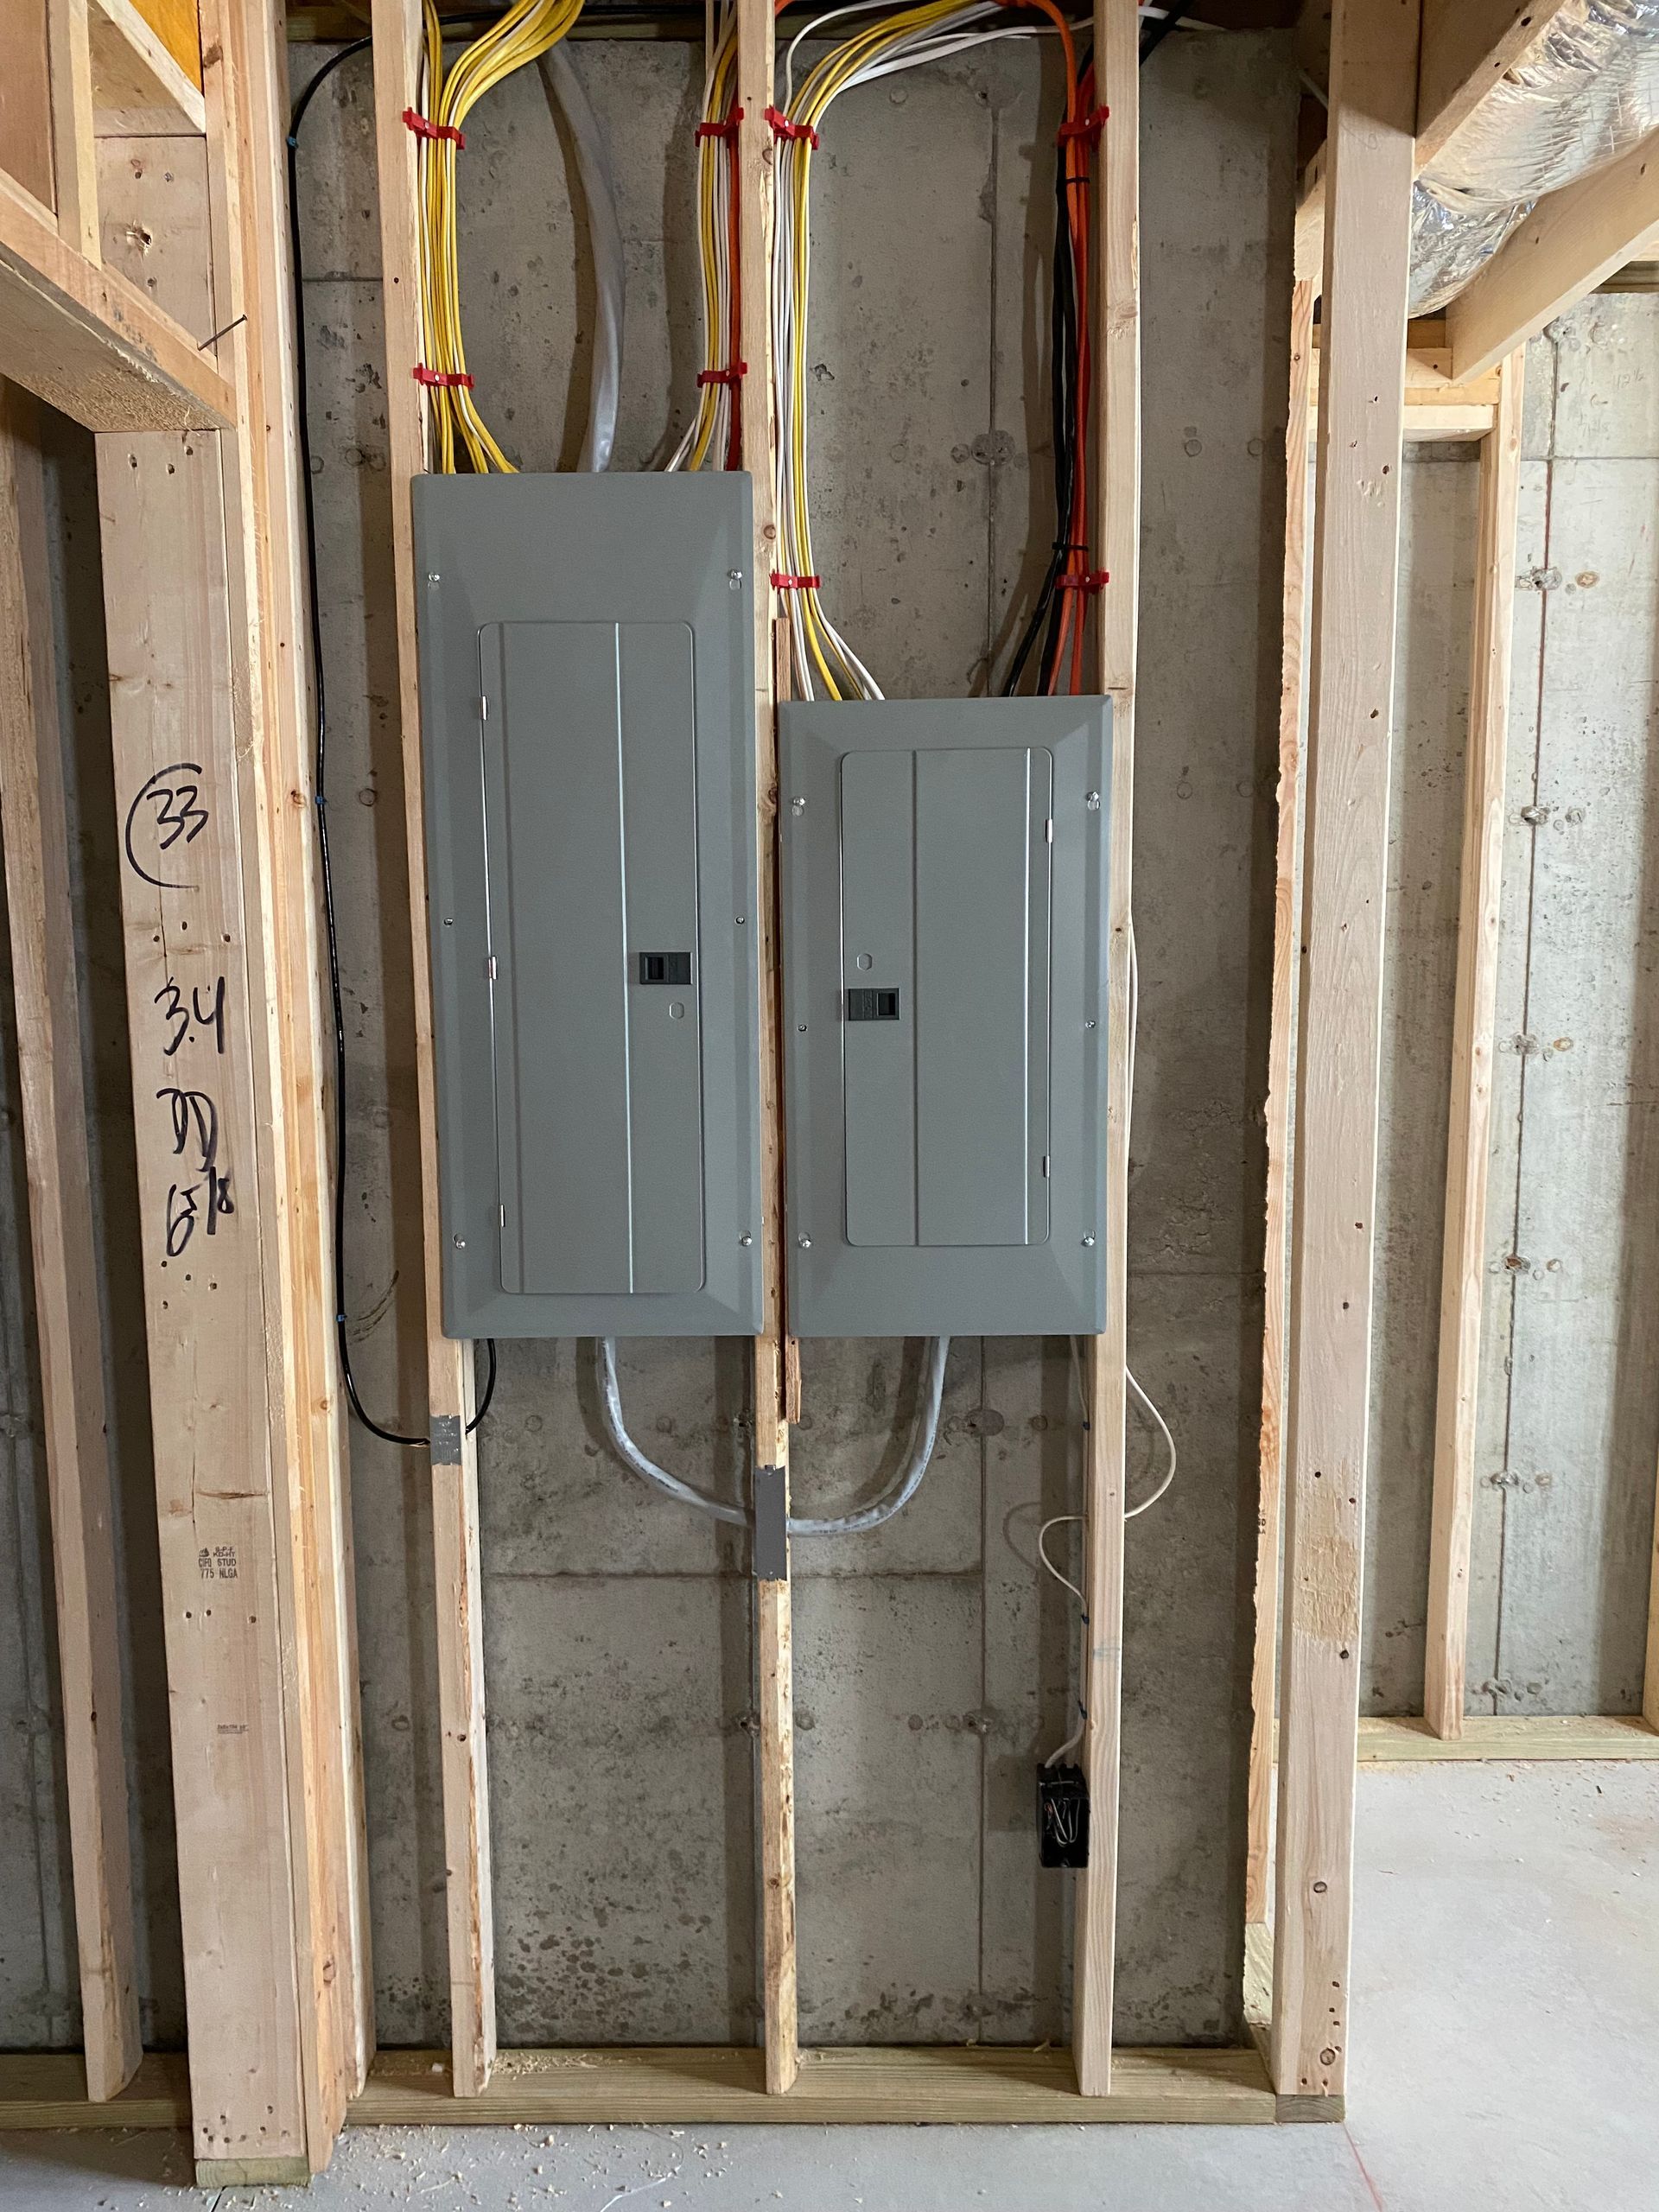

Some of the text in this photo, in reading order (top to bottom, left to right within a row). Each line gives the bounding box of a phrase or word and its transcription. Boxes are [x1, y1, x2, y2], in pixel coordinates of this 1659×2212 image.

[146, 785, 209, 850] 33
[217, 1558, 236, 1567] STUD
[219, 1567, 238, 1579] NLGA
